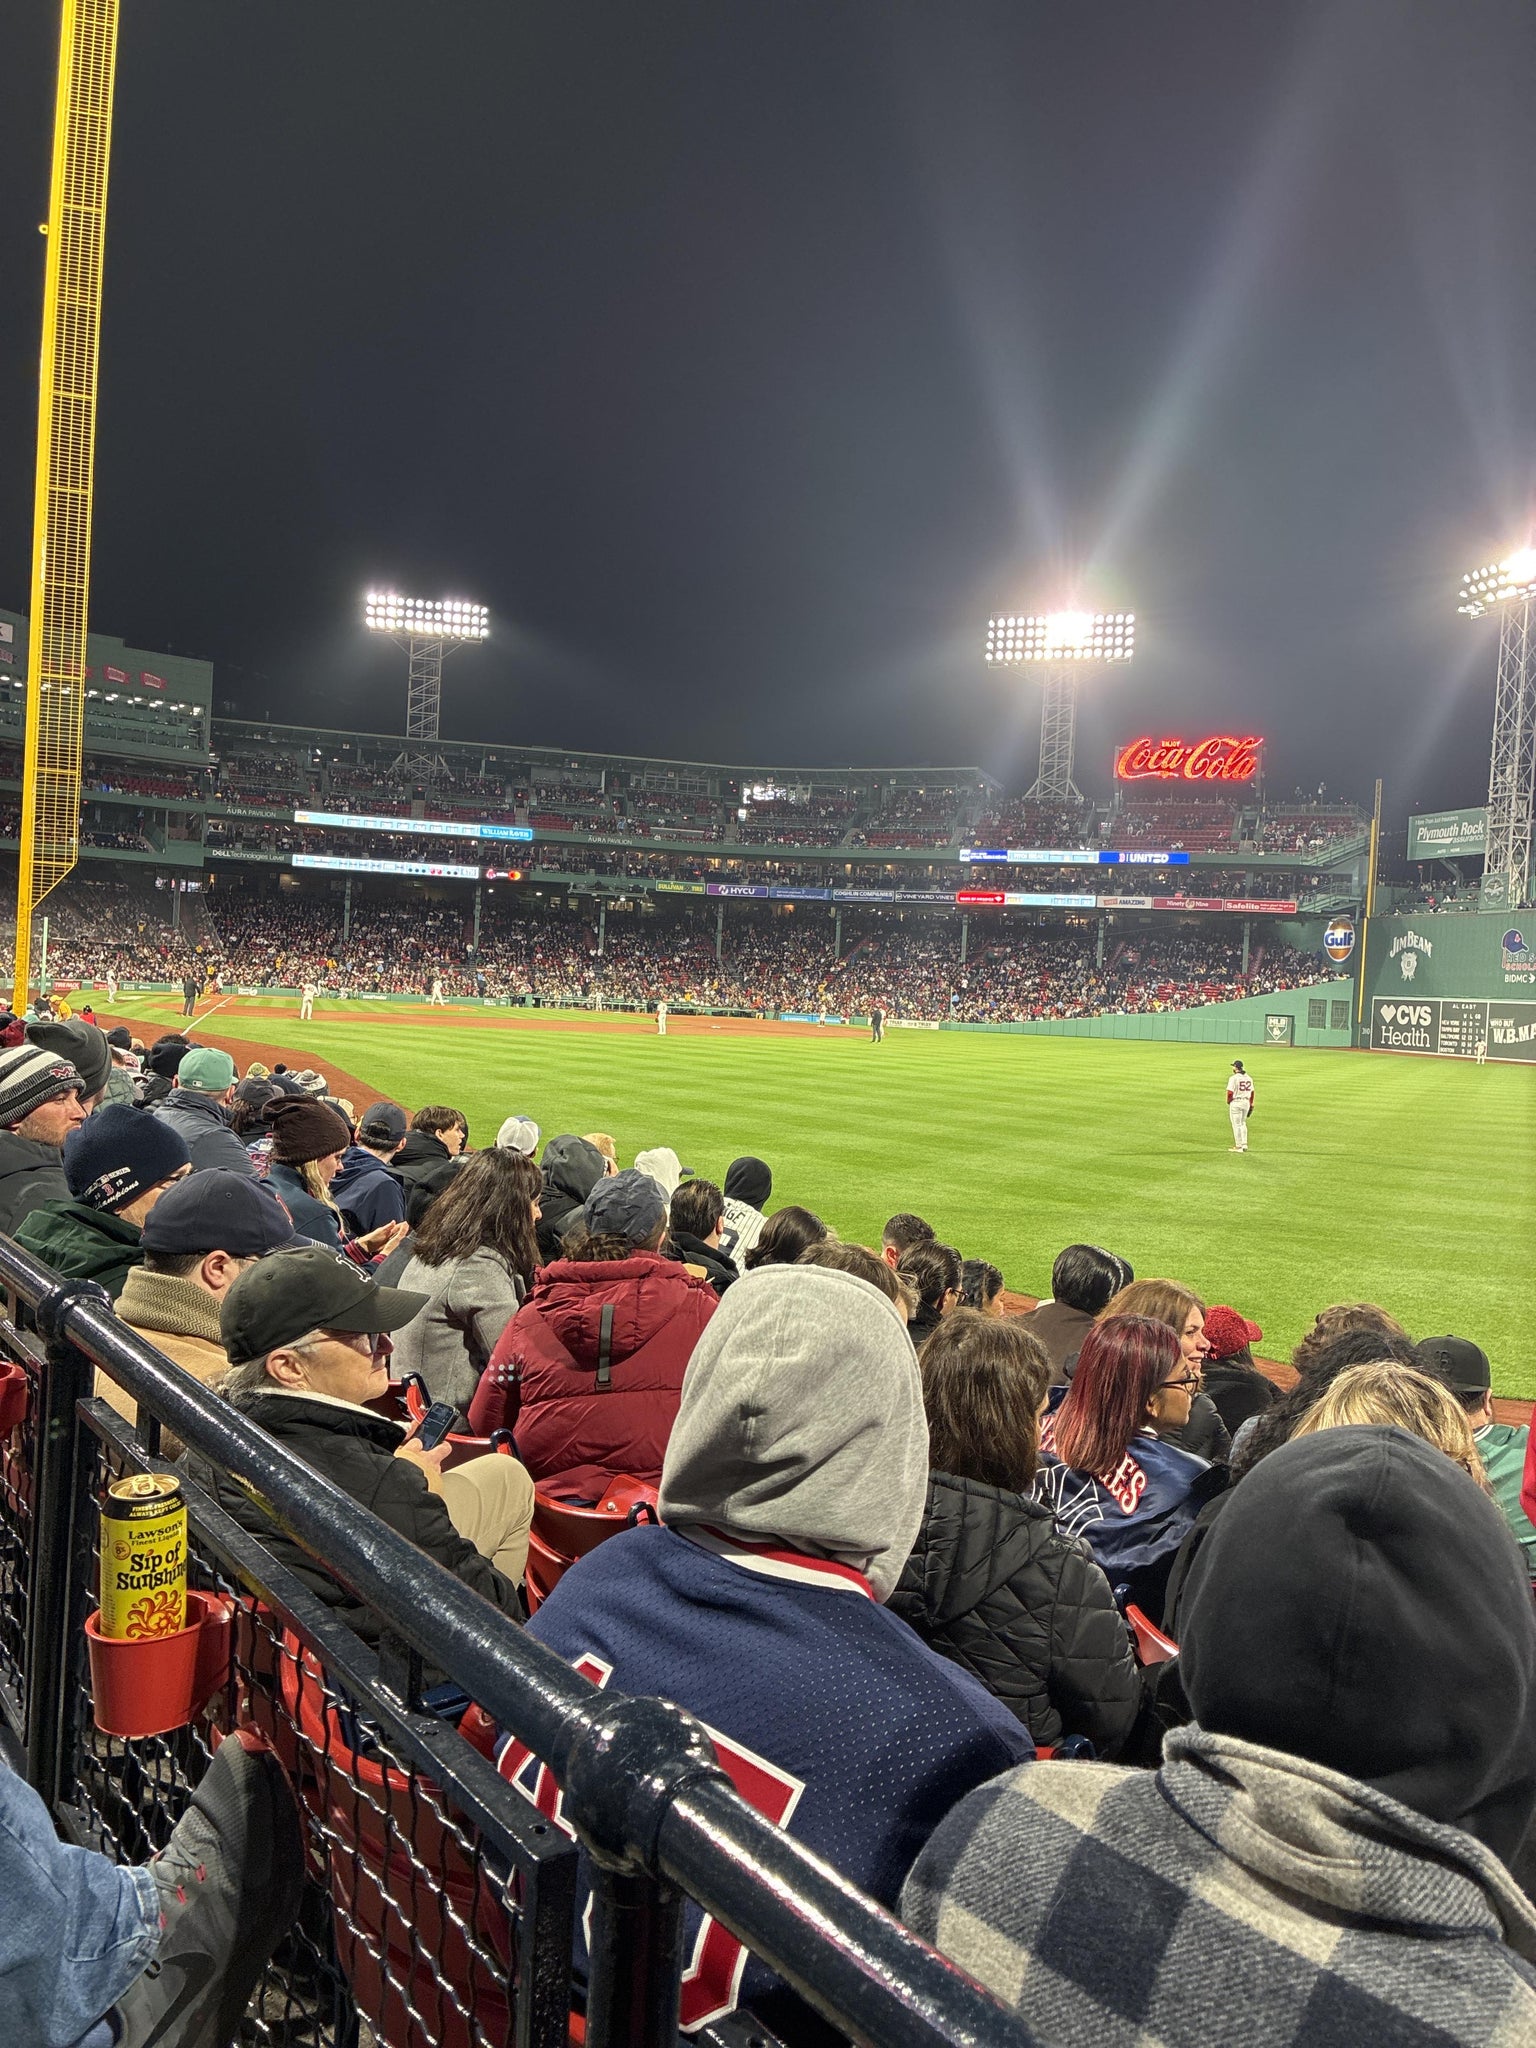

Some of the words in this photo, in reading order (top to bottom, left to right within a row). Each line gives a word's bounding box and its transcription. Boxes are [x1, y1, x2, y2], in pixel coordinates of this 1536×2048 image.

[1118, 738, 1263, 779] Coca-Cola
[248, 810, 276, 818] PAVILION
[1417, 823, 1459, 841] Plymouth
[1461, 820, 1485, 836] Rock
[607, 838, 632, 846] PAVILION
[230, 851, 268, 861] Technologies
[1130, 853, 1169, 863] UNITED
[658, 883, 684, 892] SULLIVAN
[730, 886, 755, 895] HYCU
[1226, 902, 1260, 910] Safelite
[1325, 932, 1353, 947] Gulf
[1390, 936, 1407, 958] JIM
[1407, 930, 1433, 958] BEAM
[1507, 953, 1527, 963] RED
[1504, 974, 1528, 983] BIDMC
[1396, 1005, 1432, 1026] CVS
[1381, 1026, 1430, 1048] Health
[1239, 1080, 1252, 1091] 52
[128, 1519, 183, 1540] Lawson's
[130, 1549, 162, 1573] Sip
[165, 1540, 182, 1563] of
